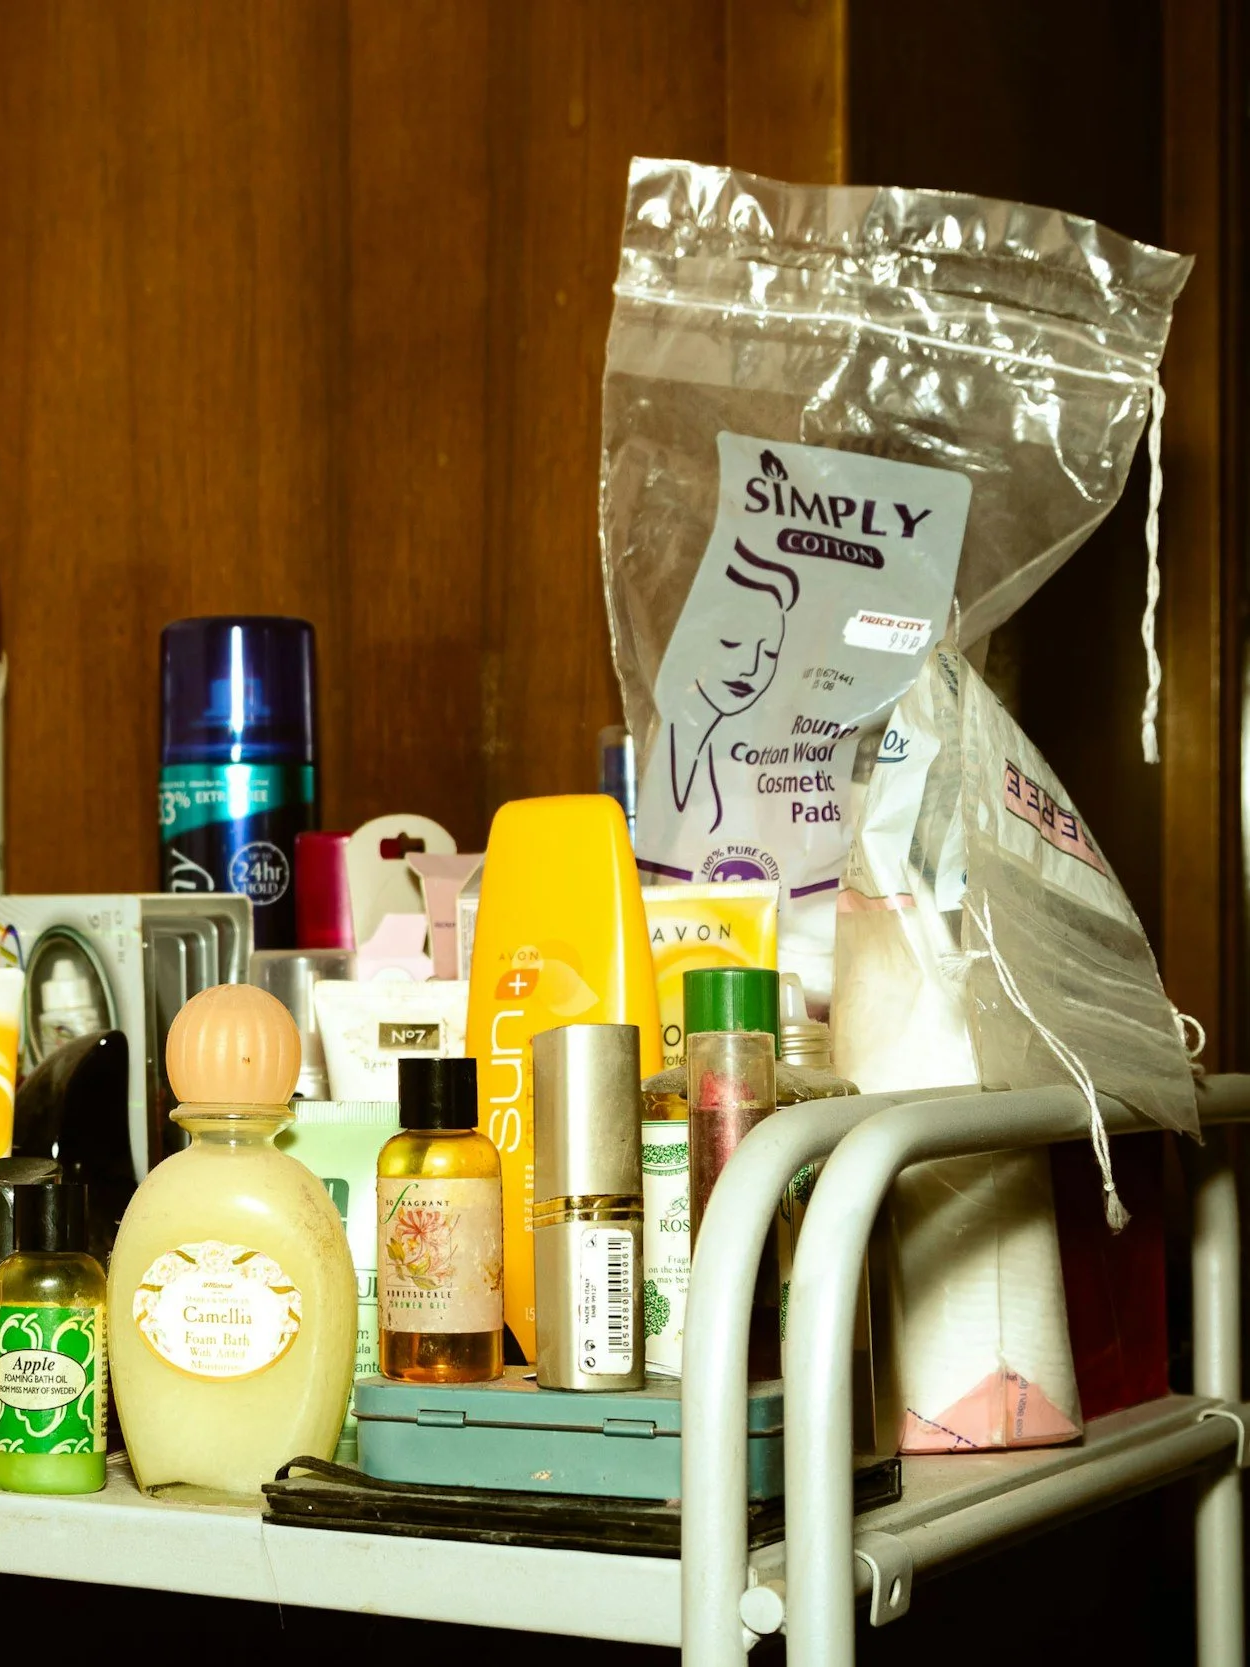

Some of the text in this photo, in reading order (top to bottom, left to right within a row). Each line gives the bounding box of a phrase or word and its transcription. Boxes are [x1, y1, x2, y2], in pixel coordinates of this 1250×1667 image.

[744, 477, 932, 538] SIMPLY
[786, 532, 875, 565] COTTON
[859, 615, 925, 632] PRICE CITY
[792, 715, 859, 740] Round
[731, 742, 836, 765] Cotton Wool
[758, 770, 836, 794] Cosmetic
[159, 790, 191, 826] 3%
[792, 802, 841, 823] Pads
[238, 861, 282, 882] 24hr
[701, 846, 780, 881] 100% PURE COTTO
[652, 923, 731, 943] AVON
[499, 951, 540, 962] AVON
[664, 1053, 687, 1066] rote
[489, 1009, 524, 1154] sun
[660, 1219, 690, 1233] ROS
[668, 1255, 689, 1265] Fragr
[387, 1290, 452, 1299] HONEYSUCKLE
[183, 1306, 252, 1325] Camellia
[622, 1297, 631, 1347] 054080
[185, 1331, 250, 1346] Foam Bath
[355, 1344, 371, 1354] ula
[12, 1356, 56, 1375] Apple
[355, 1362, 381, 1373] ant
[4, 1374, 68, 1384] FOAMING BATH OIL
[11, 1386, 22, 1394] MISS
[50, 1387, 77, 1395] SWEDEN
